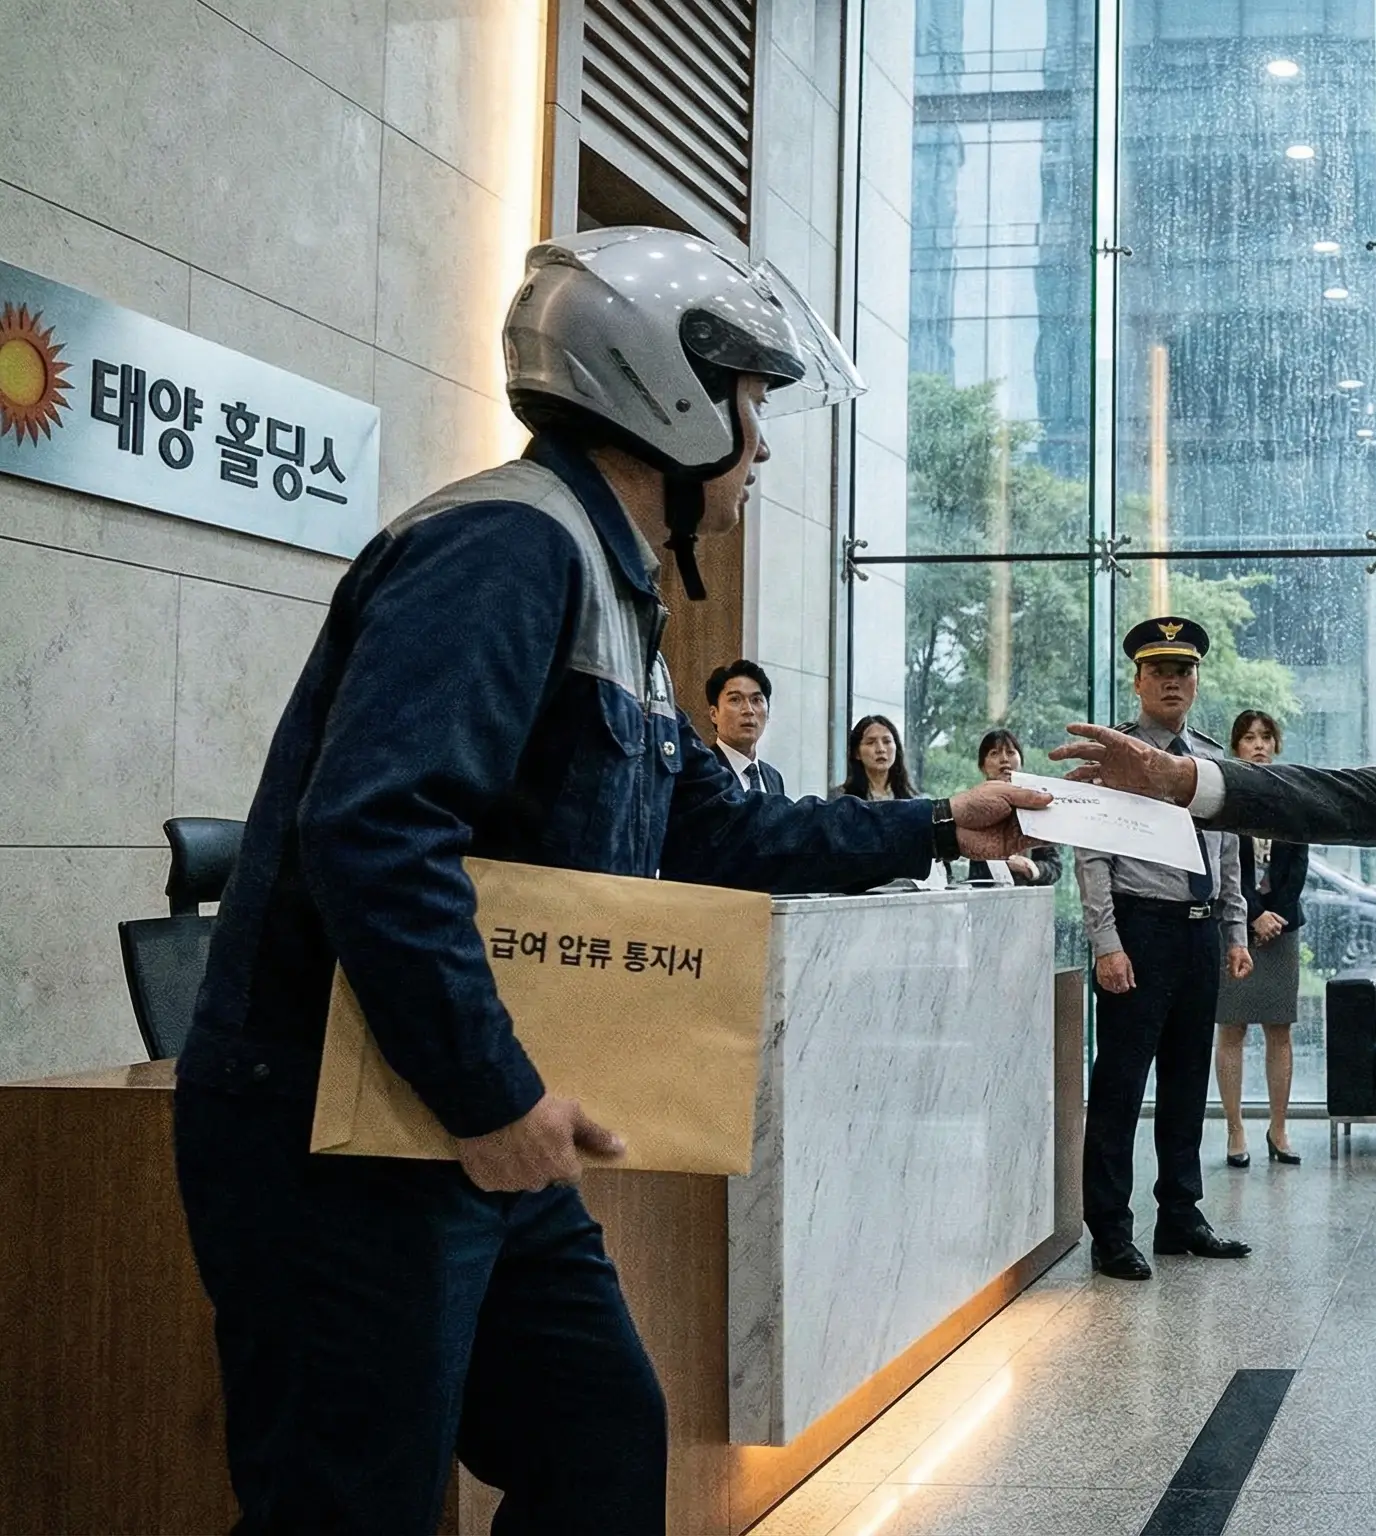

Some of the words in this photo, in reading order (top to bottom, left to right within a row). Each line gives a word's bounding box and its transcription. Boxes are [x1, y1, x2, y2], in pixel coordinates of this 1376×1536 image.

[90, 358, 204, 470] 태양
[215, 400, 348, 505] 홀딩스
[489, 927, 548, 963] 급여
[558, 934, 612, 970] 압류
[622, 940, 703, 979] 통지서
